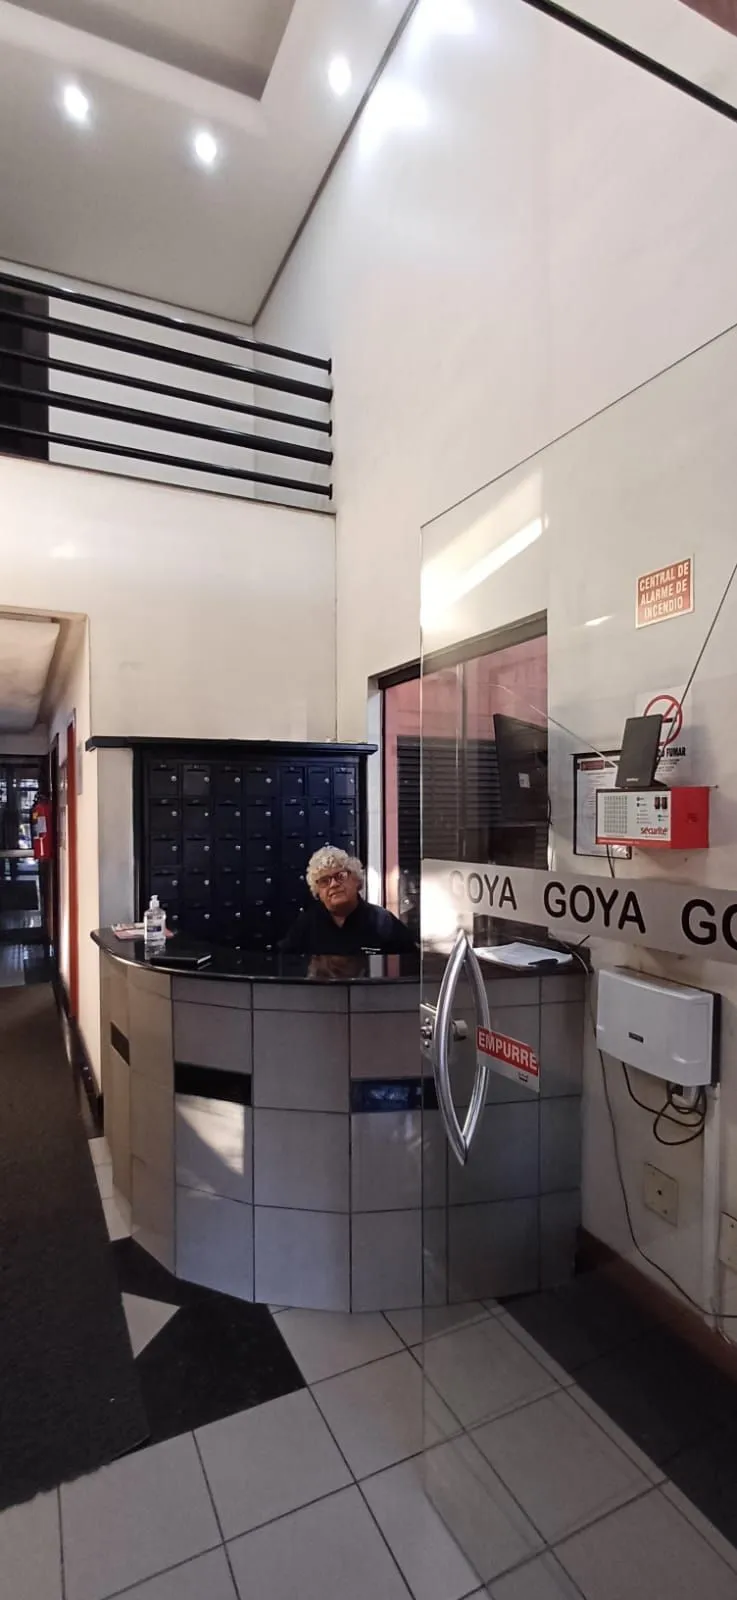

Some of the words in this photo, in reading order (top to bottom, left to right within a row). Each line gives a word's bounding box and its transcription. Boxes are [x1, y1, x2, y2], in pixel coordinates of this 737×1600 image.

[640, 568, 676, 592] CENTRAL
[677, 562, 689, 578] DE
[641, 583, 674, 605] ALARME
[675, 578, 688, 594] DE
[449, 870, 517, 910] GOYA
[543, 881, 647, 934] GOYA
[478, 1031, 538, 1070] EMPURRE
